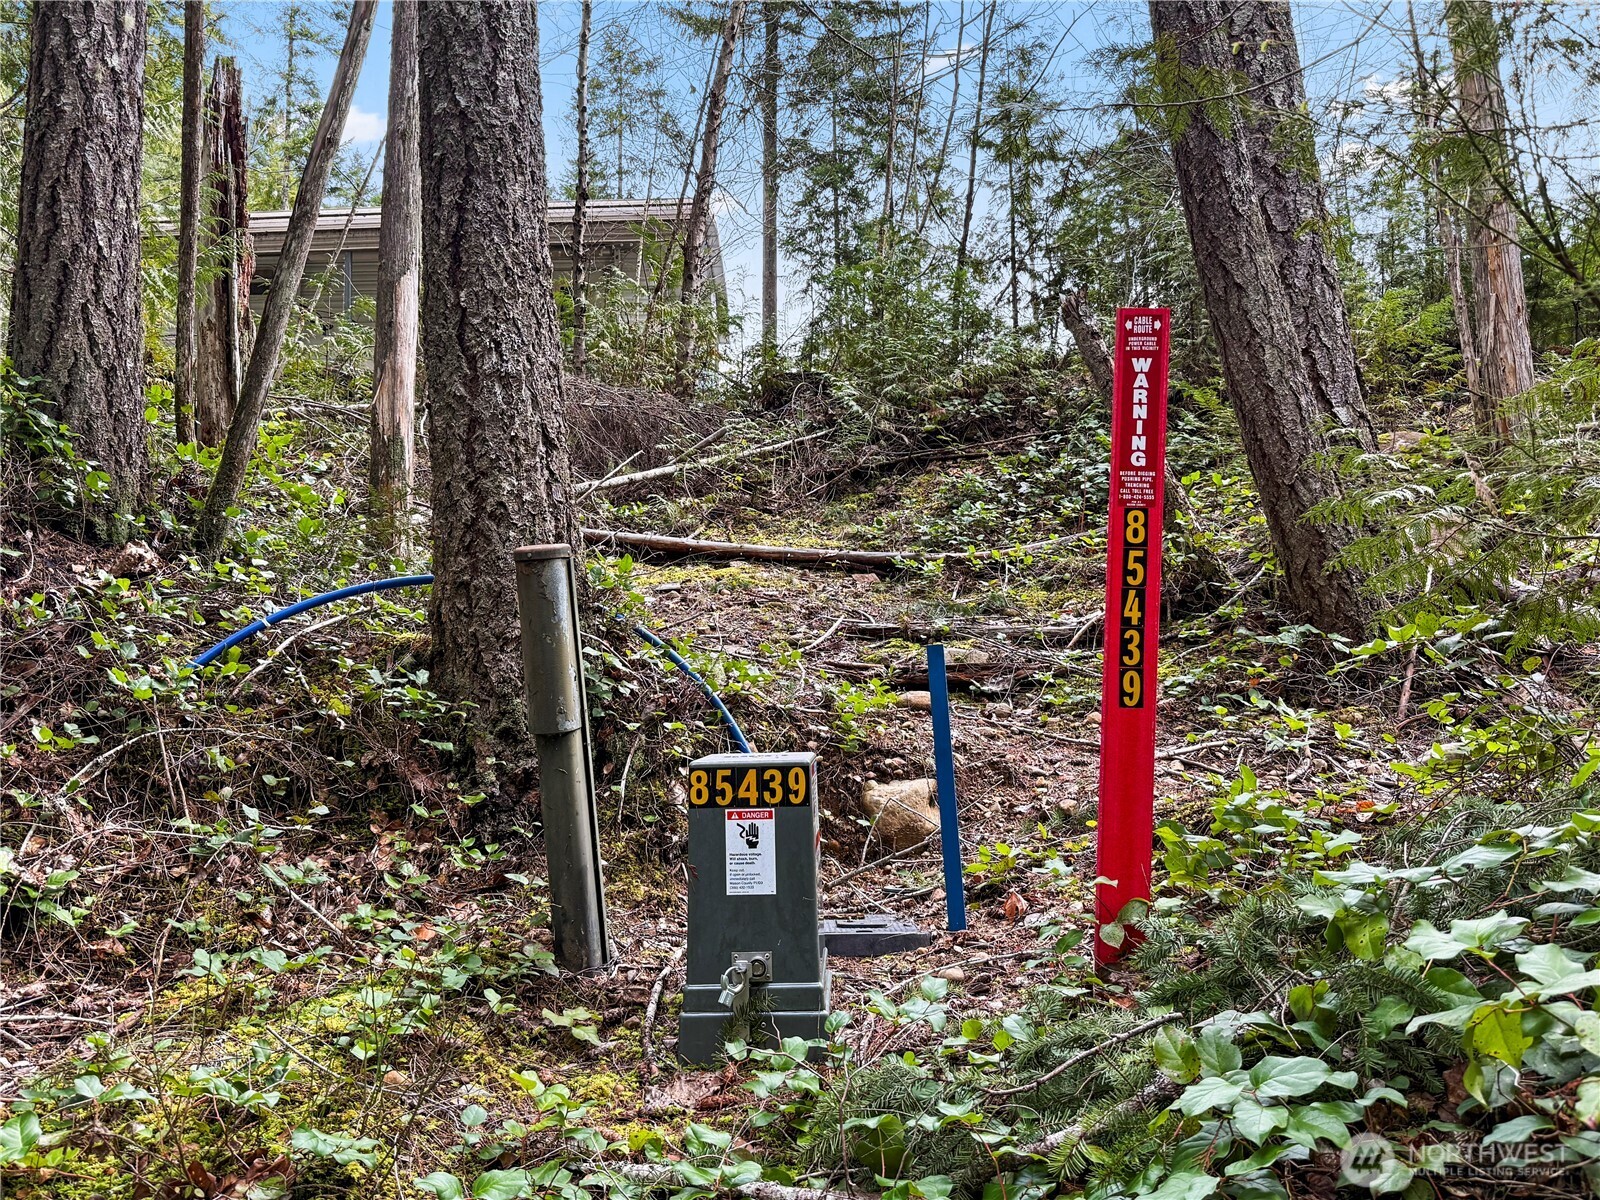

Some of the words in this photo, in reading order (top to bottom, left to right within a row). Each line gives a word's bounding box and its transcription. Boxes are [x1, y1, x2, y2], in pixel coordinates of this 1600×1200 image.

[1133, 316, 1153, 325] CABLE
[1133, 325, 1153, 334] ROUTE
[1130, 357, 1152, 467] WARNING
[1122, 509, 1146, 707] 85439
[689, 766, 806, 806] 85439
[741, 811, 769, 819] DANGER
